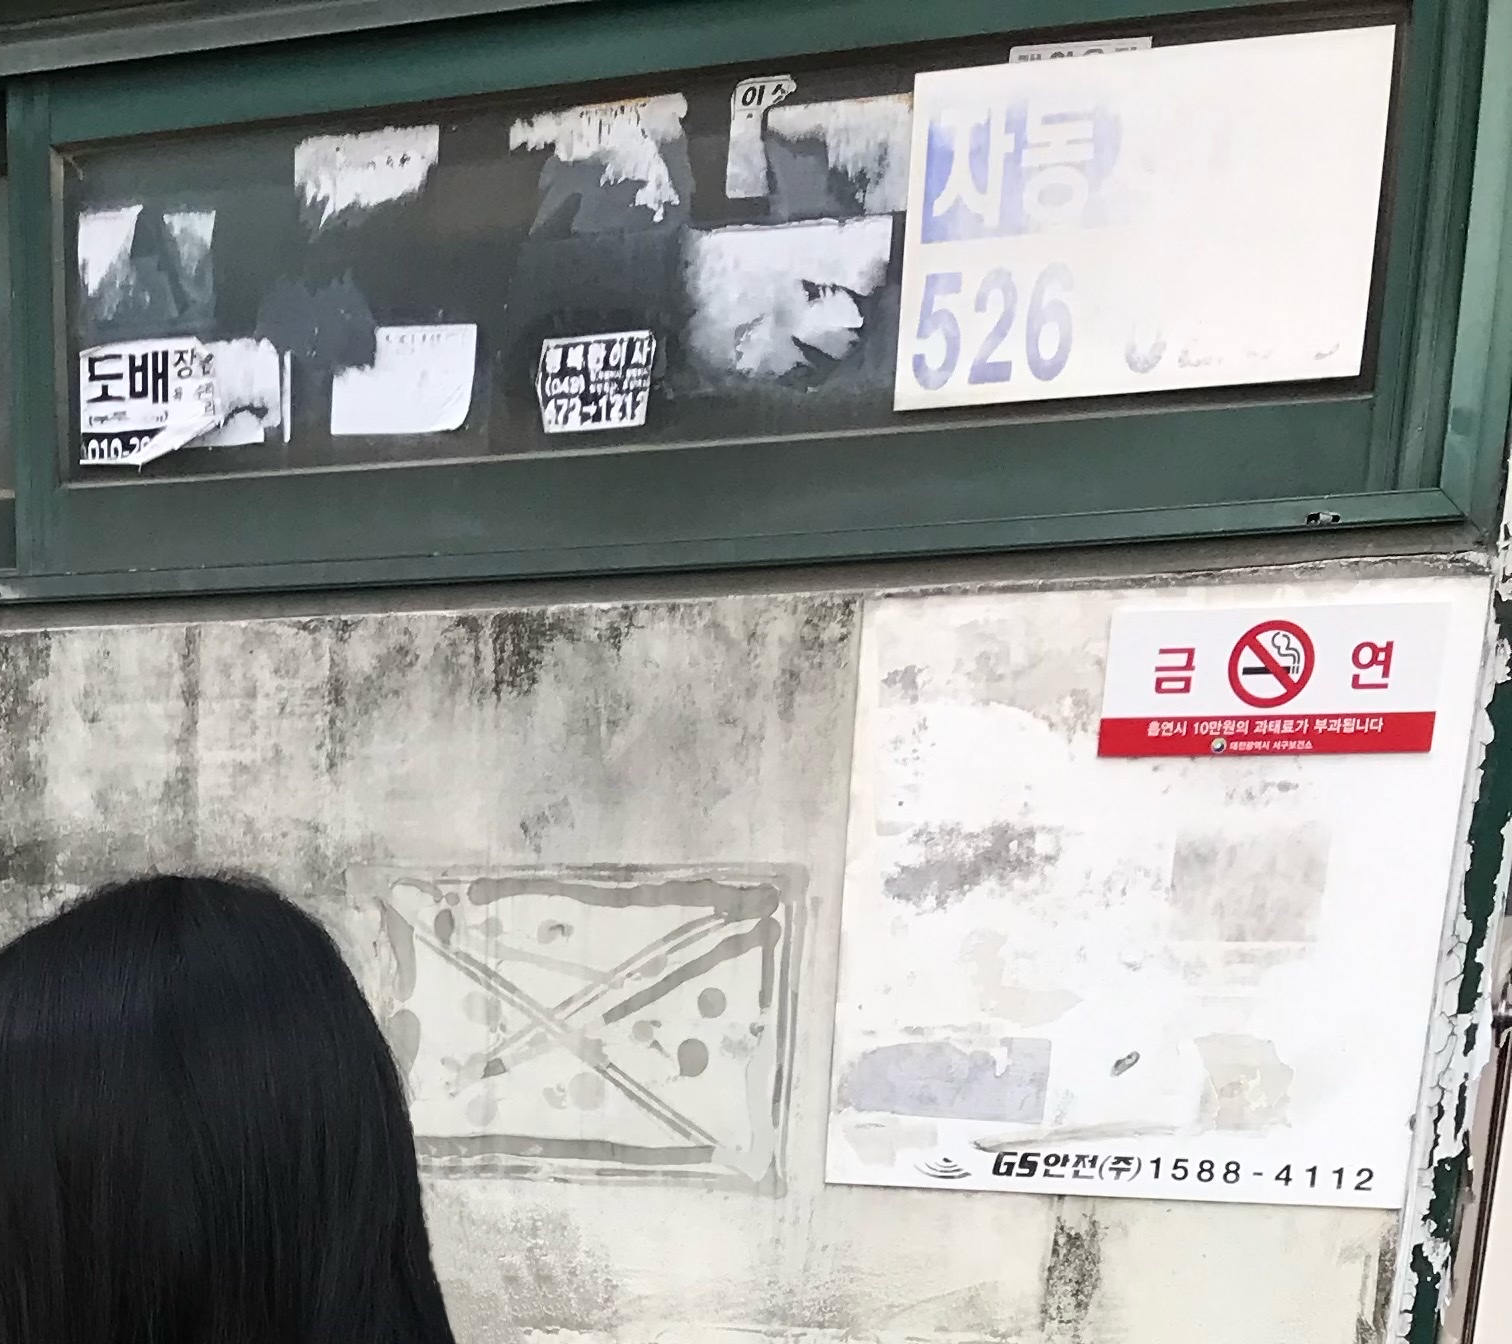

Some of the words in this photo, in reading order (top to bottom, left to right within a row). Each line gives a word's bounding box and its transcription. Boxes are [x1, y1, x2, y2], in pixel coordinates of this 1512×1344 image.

[911, 261, 1074, 392] 526
[86, 349, 169, 404] 도배
[1154, 647, 1196, 695] 금
[1350, 640, 1395, 691] 연
[1192, 719, 1250, 736] 10만원의
[1253, 718, 1309, 735] 과태료가
[1313, 716, 1384, 734] 부과됩니다
[991, 1151, 1142, 1182] GS안전(주)
[1149, 1156, 1375, 1192] 1588-4112
